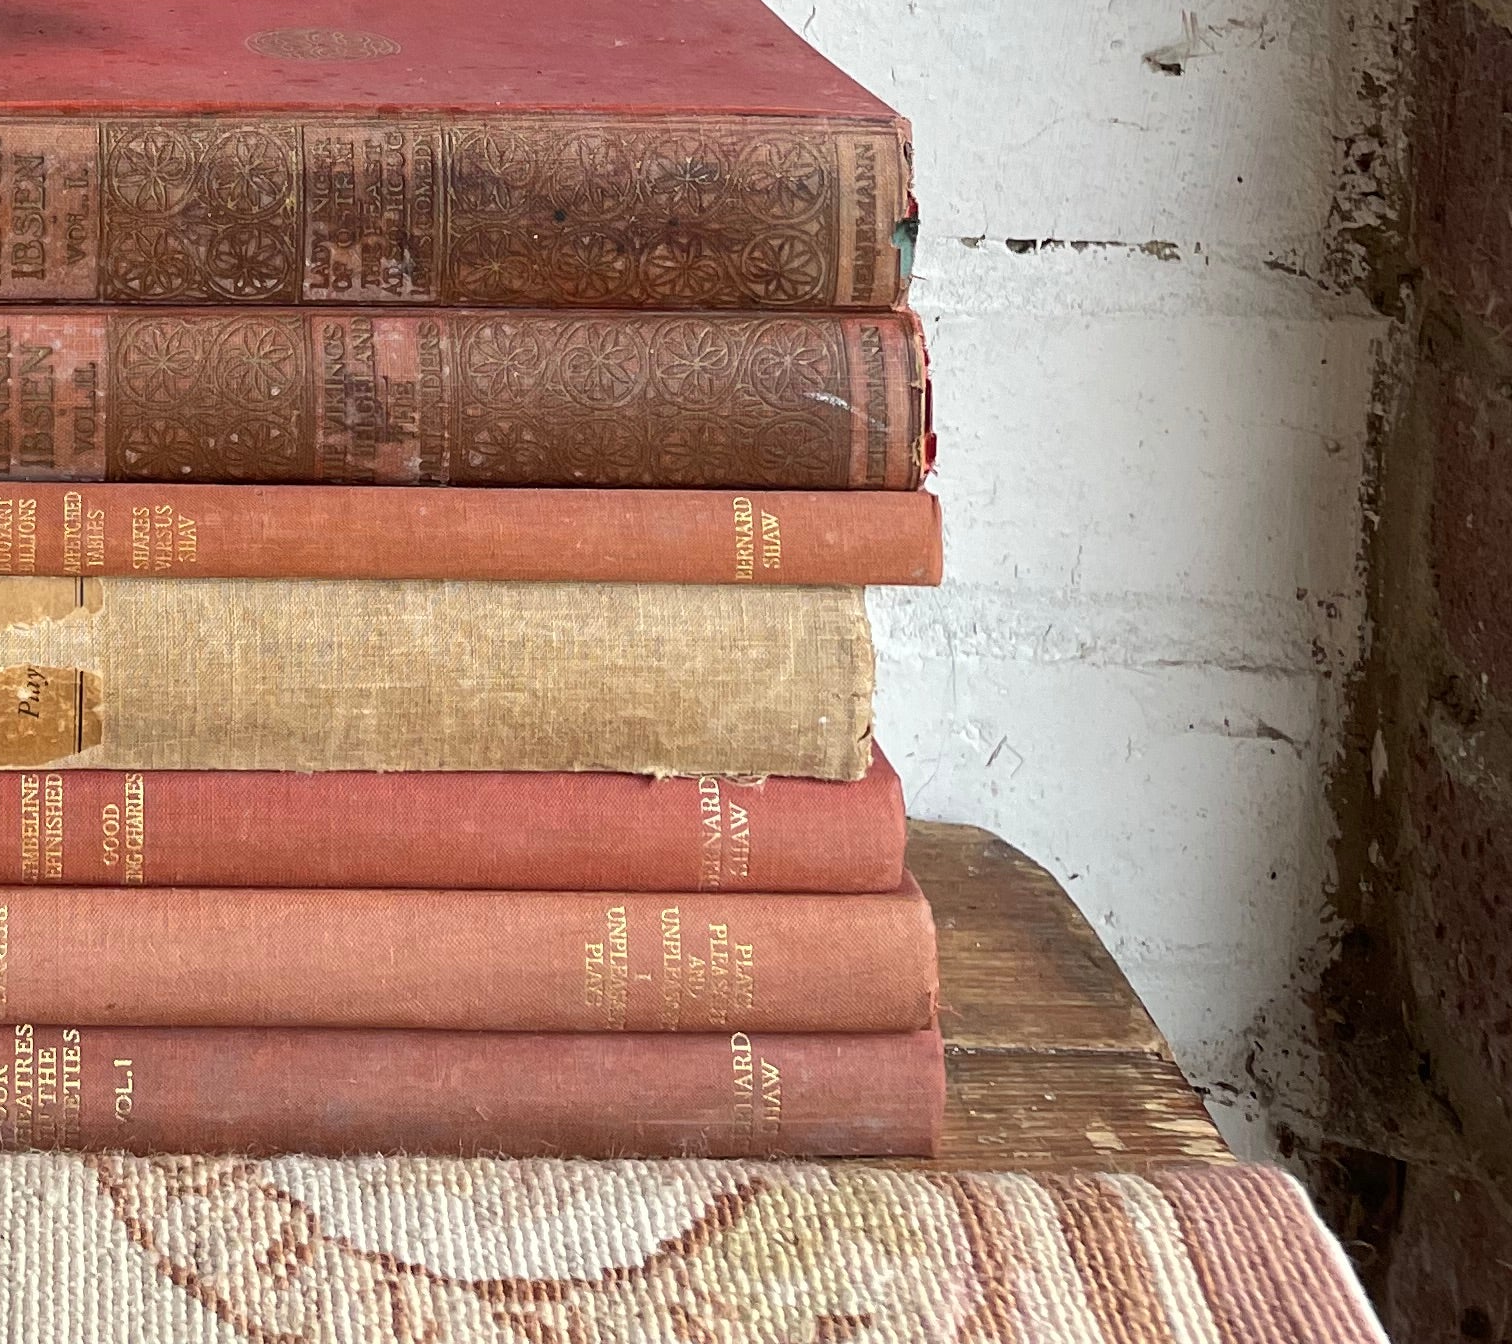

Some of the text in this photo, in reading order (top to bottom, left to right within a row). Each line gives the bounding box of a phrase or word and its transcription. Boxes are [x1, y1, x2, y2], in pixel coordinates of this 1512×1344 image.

[11, 153, 45, 280] IBSEN
[361, 140, 382, 288] THE FEAST
[310, 229, 329, 290] LADY
[332, 262, 352, 292] OF
[19, 341, 54, 468] IBSEN
[323, 323, 346, 433] VIKINGS
[19, 499, 37, 573] BILLIONS
[64, 491, 82, 573] ARFETCHED
[133, 507, 150, 569] SHAKES
[155, 505, 173, 571] VERSUS
[733, 497, 754, 580] BERNARD
[761, 509, 781, 569] SHAW
[22, 774, 39, 882] MBELINE
[45, 773, 63, 881] EFINISHED
[103, 804, 119, 865] GOOD
[125, 773, 143, 884] ING CHARLES
[15, 1023, 33, 1147] HEATRES
[38, 1047, 57, 1106] THE
[731, 1032, 753, 1151] ERNARD
